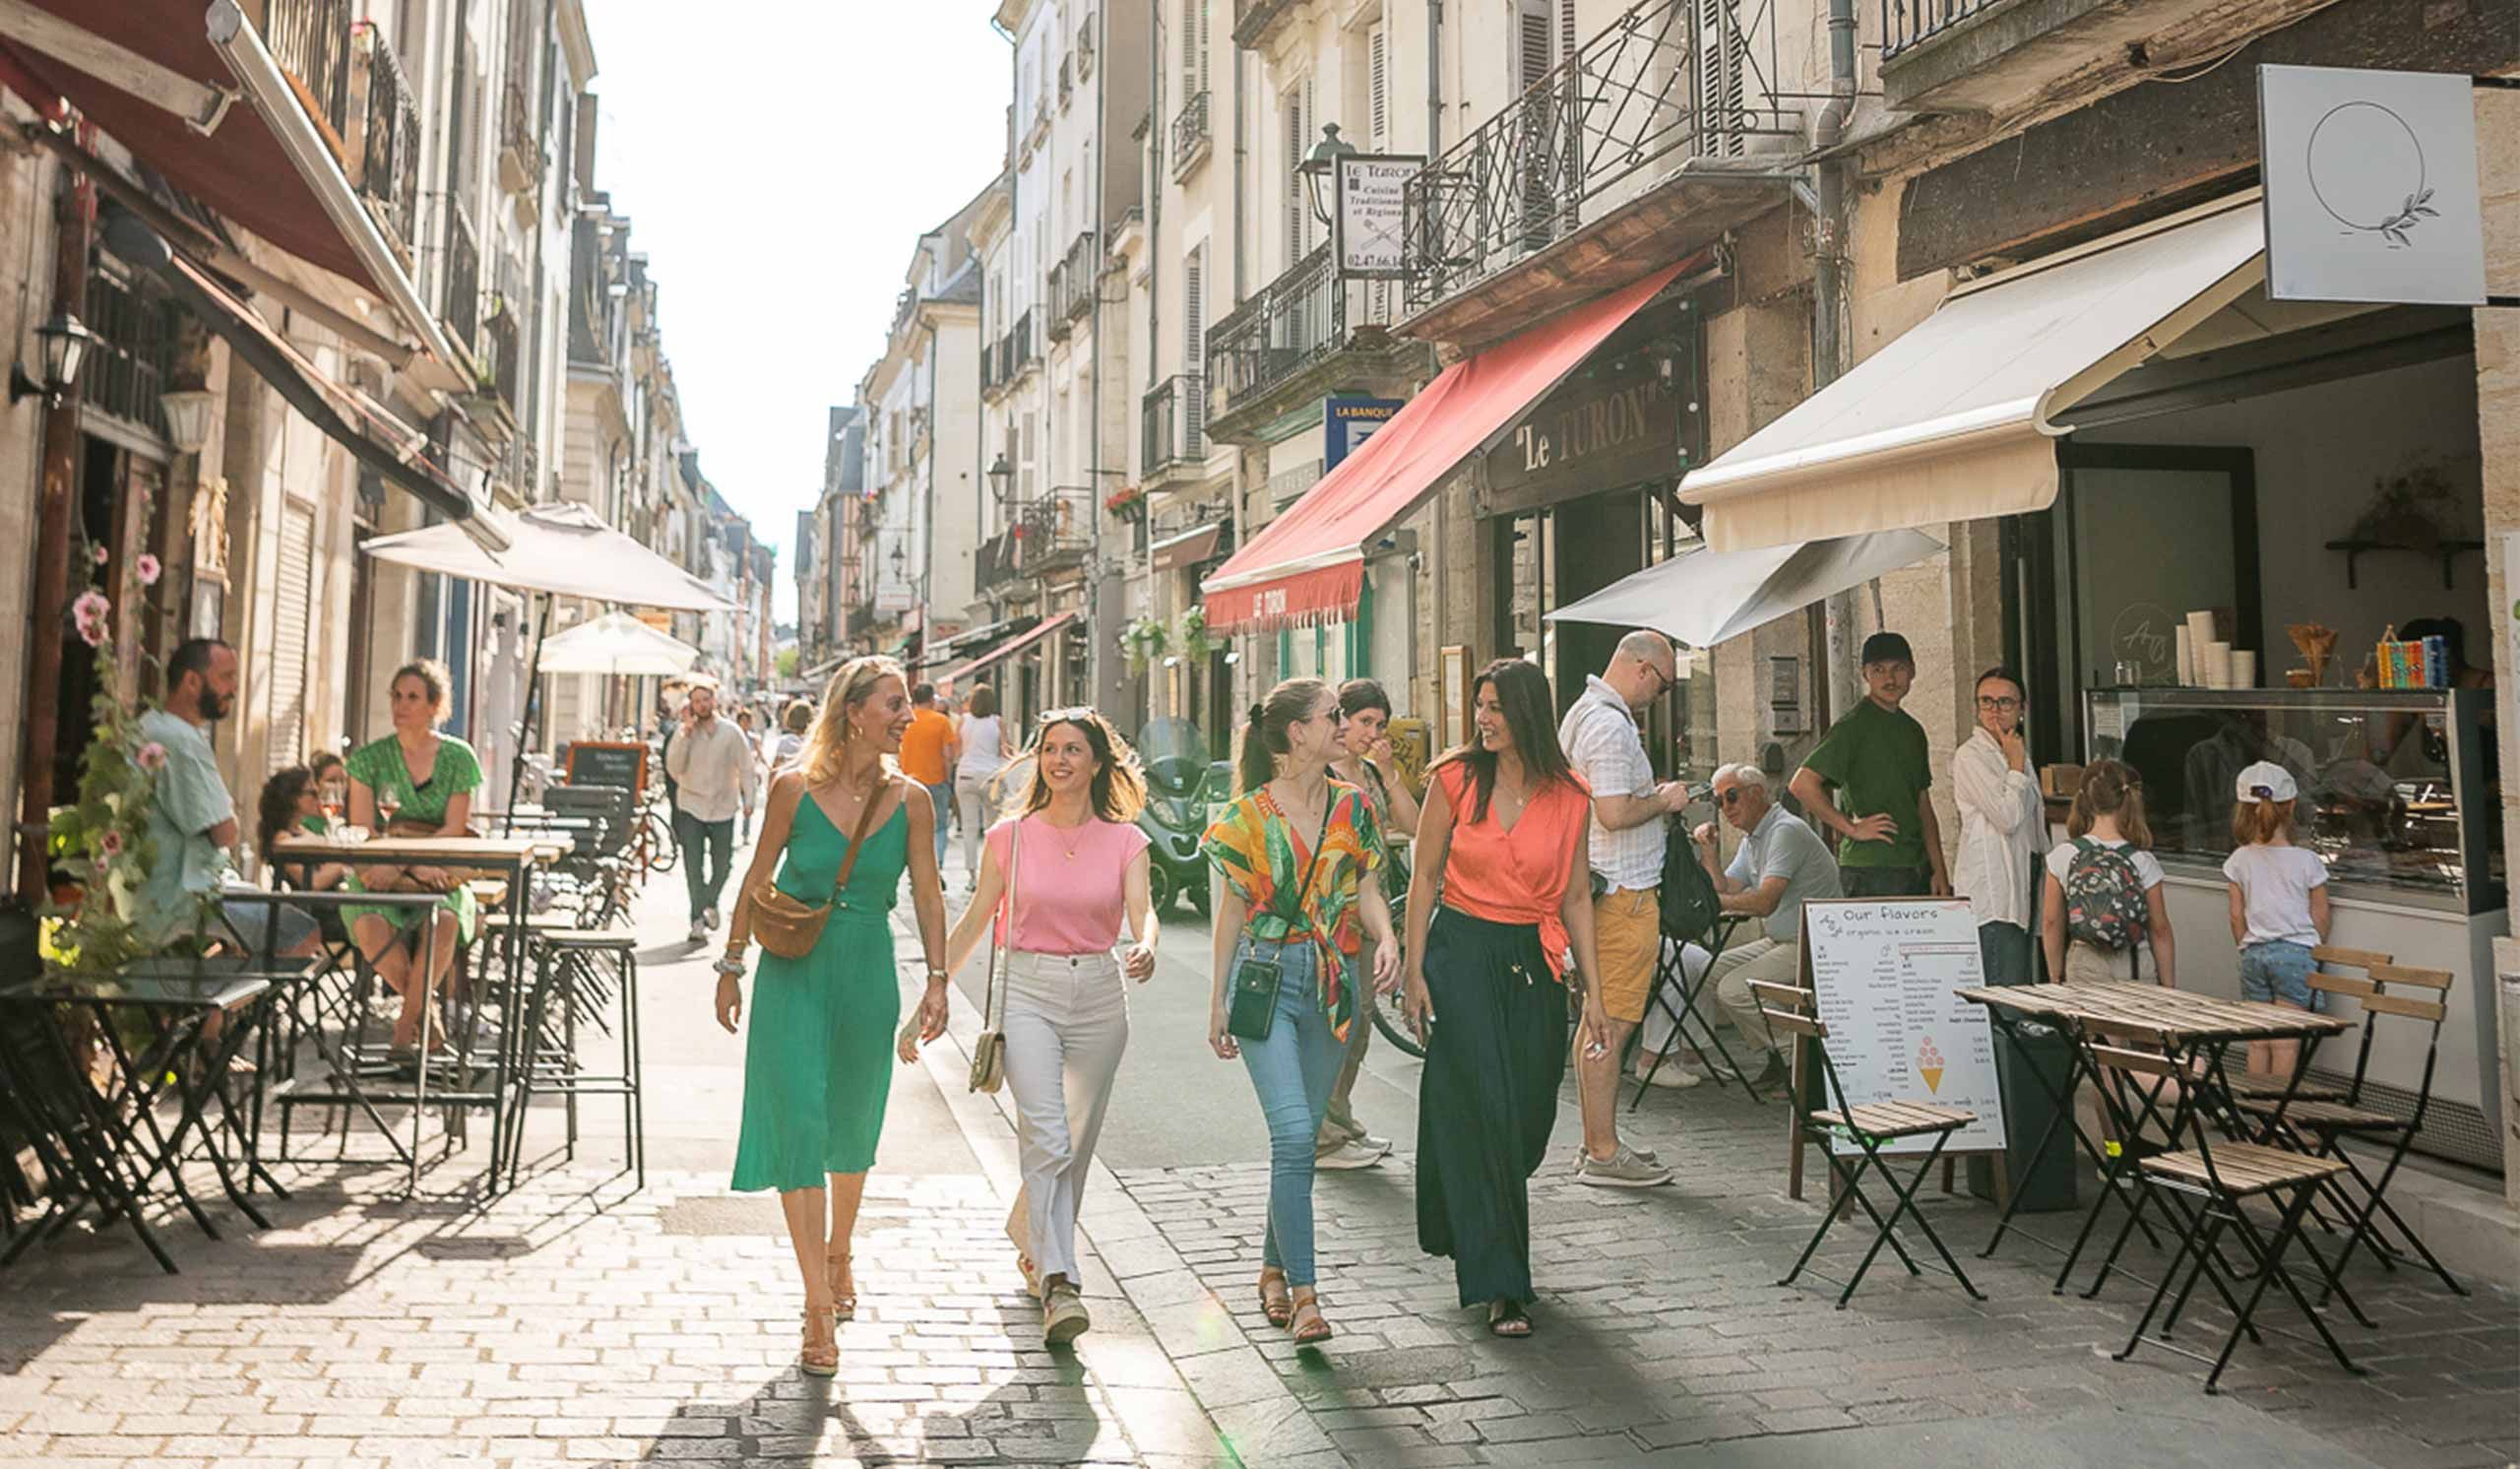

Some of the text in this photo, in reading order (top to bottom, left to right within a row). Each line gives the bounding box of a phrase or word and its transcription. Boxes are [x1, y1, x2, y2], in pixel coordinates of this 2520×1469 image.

[1363, 186, 1399, 195] Cuisine
[1335, 407, 1348, 417] LA
[1843, 906, 1938, 922] Our flavors
